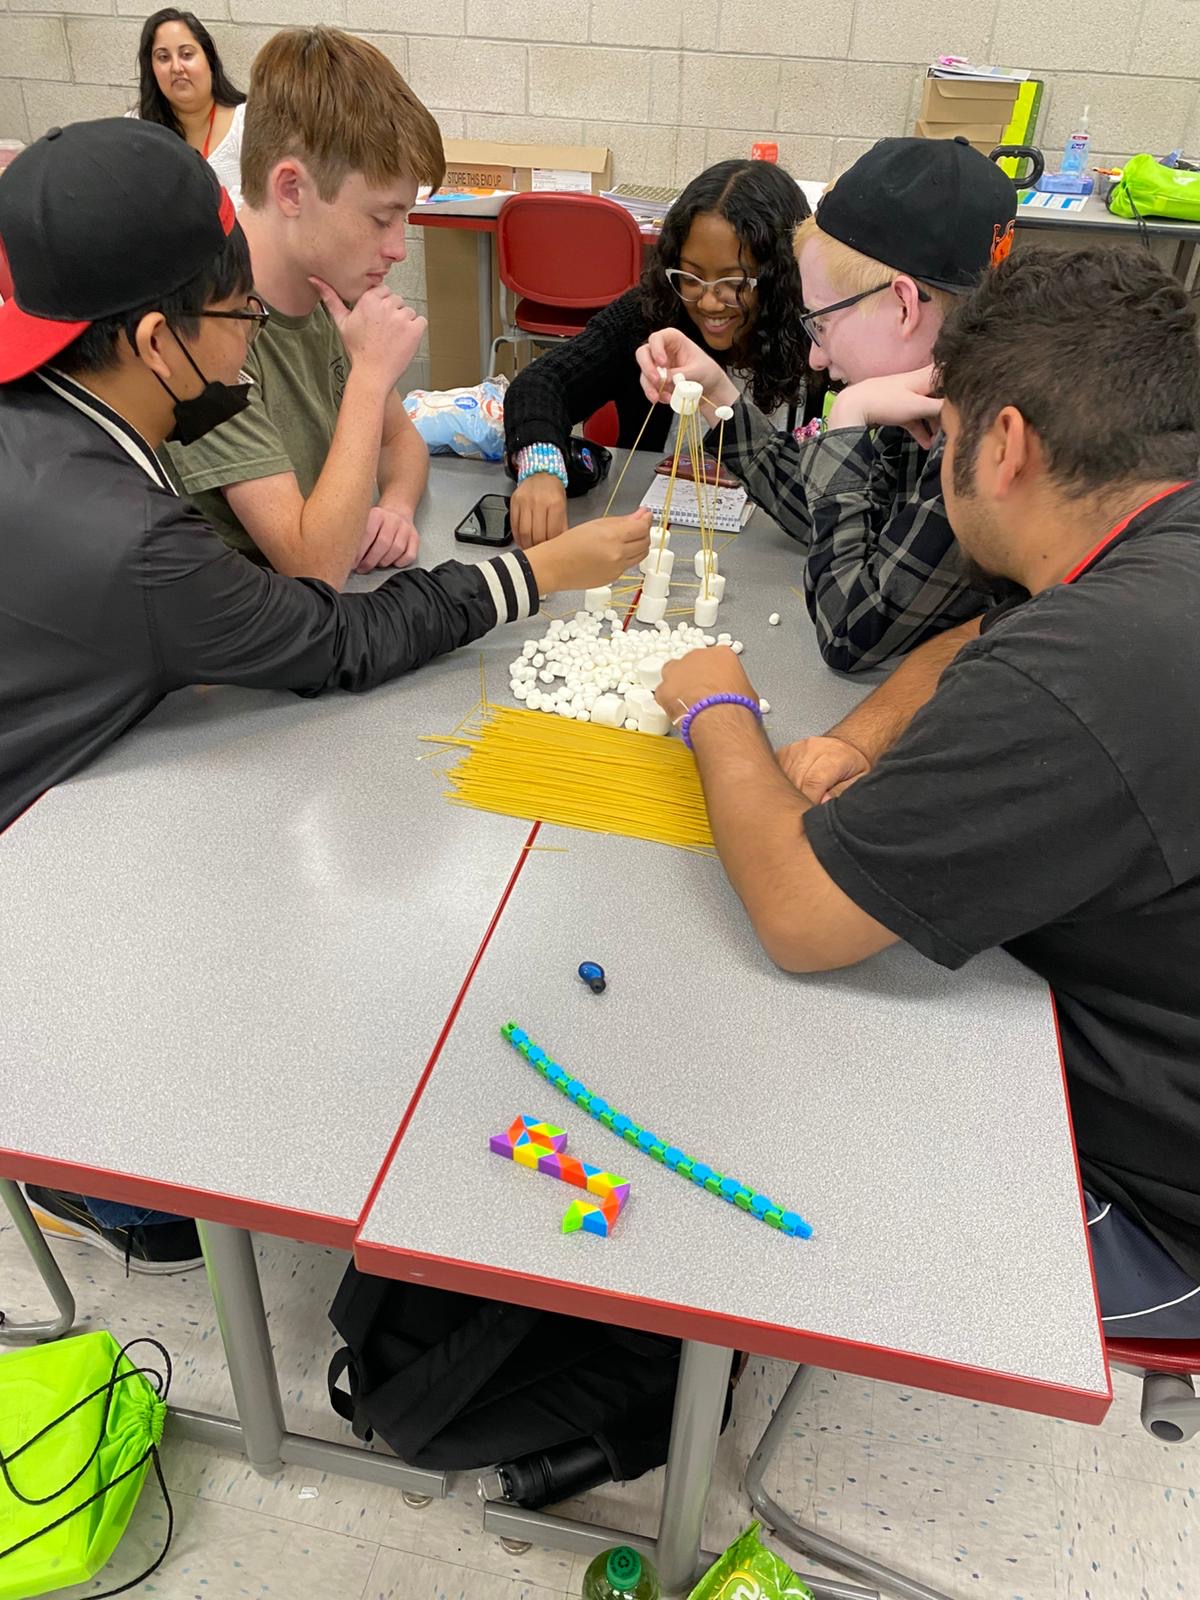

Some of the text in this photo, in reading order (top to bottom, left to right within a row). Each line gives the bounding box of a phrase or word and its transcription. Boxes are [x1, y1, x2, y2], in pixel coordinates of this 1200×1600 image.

[447, 171, 502, 187] STORE THIS END UP
